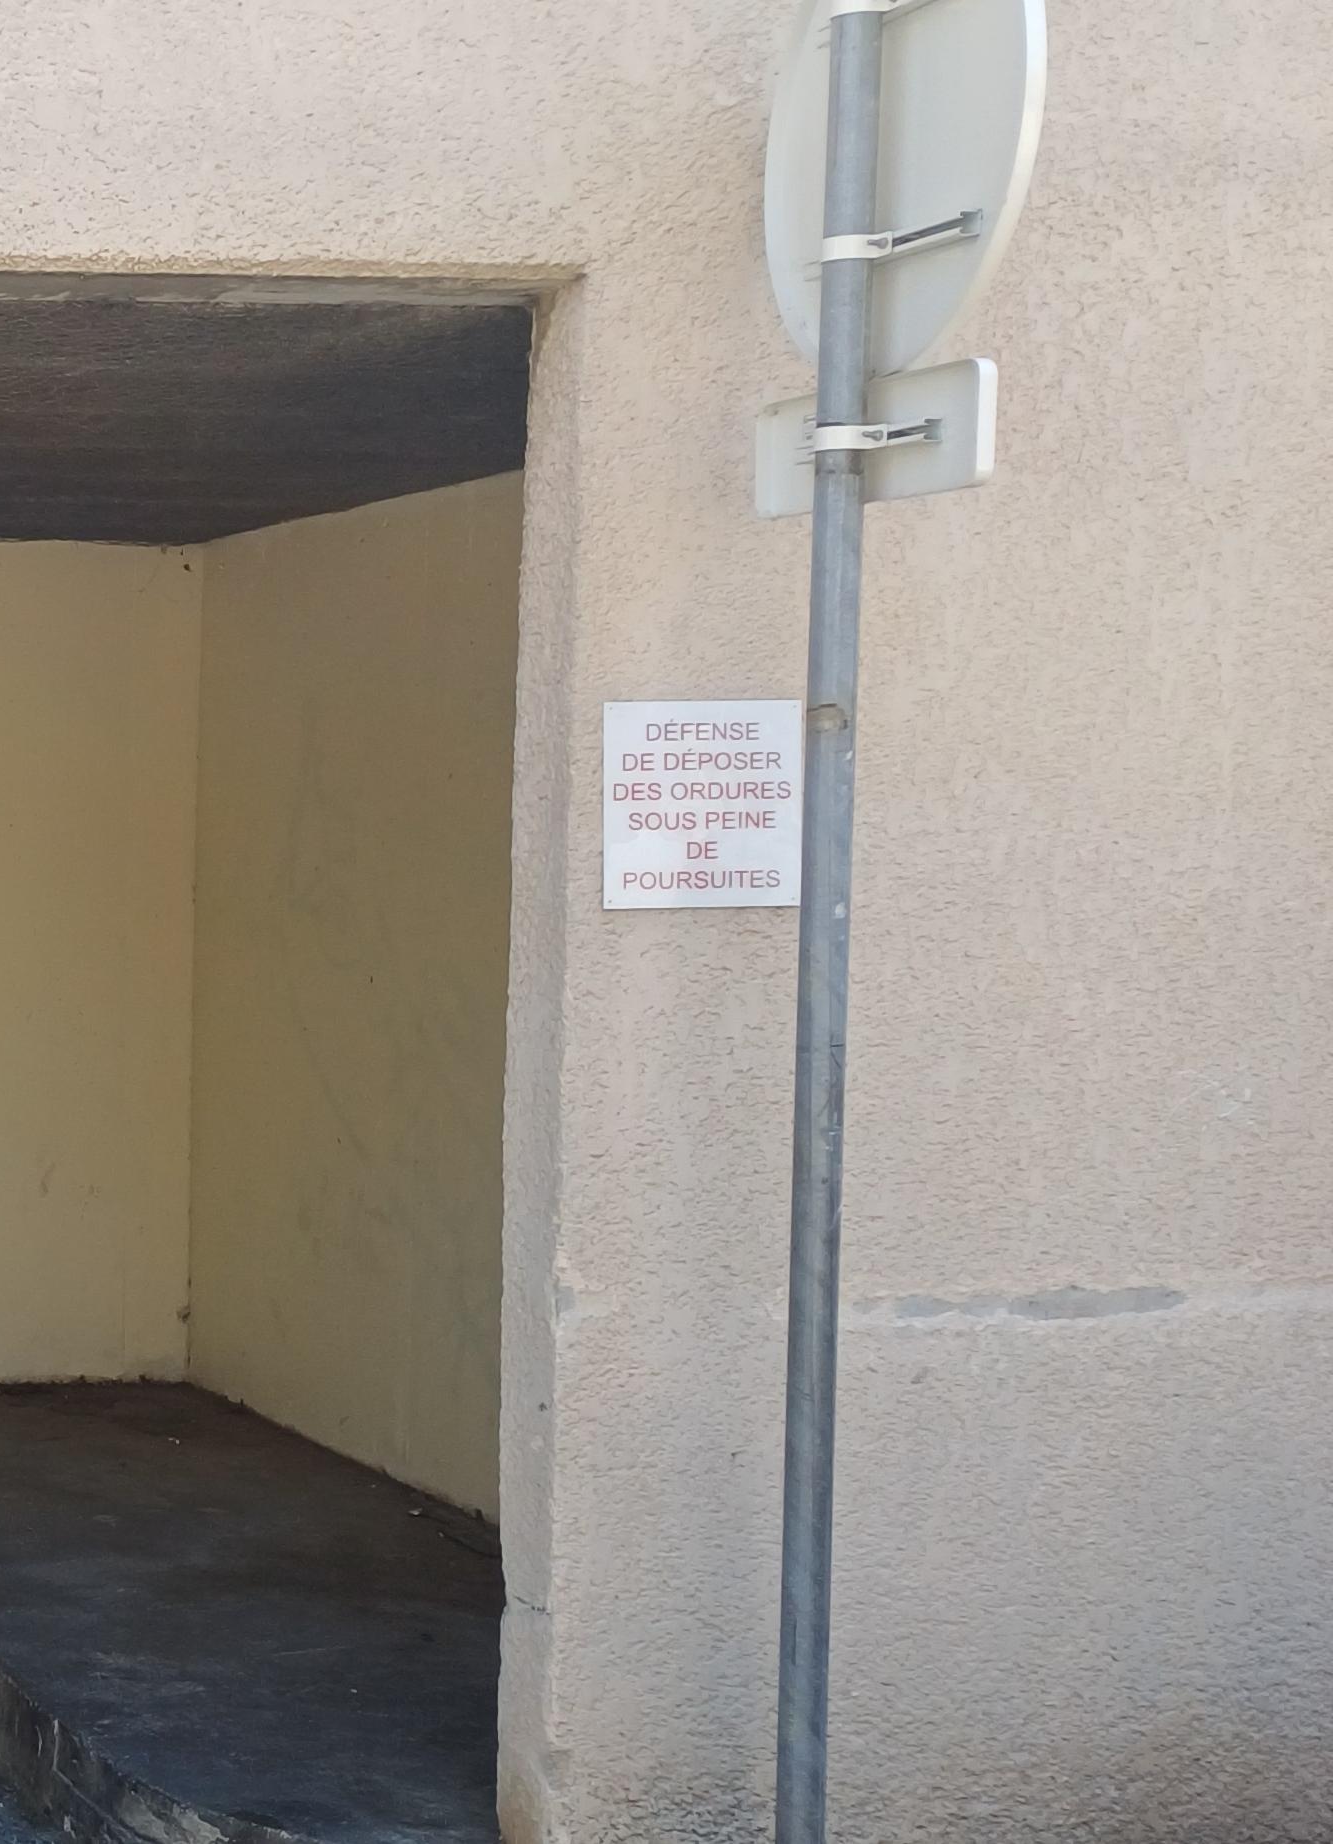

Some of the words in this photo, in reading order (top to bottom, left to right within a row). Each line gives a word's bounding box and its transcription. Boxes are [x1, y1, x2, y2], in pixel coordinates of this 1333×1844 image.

[646, 719, 760, 741] DÉFENSE
[622, 753, 655, 772] DE
[663, 748, 782, 771] DÉPOSER
[613, 782, 662, 801] DES
[670, 781, 792, 800] ORDURES
[628, 811, 697, 831] SOUS
[705, 811, 777, 830] PEINE
[686, 841, 719, 860] DE
[623, 870, 781, 890] POURSUITES
